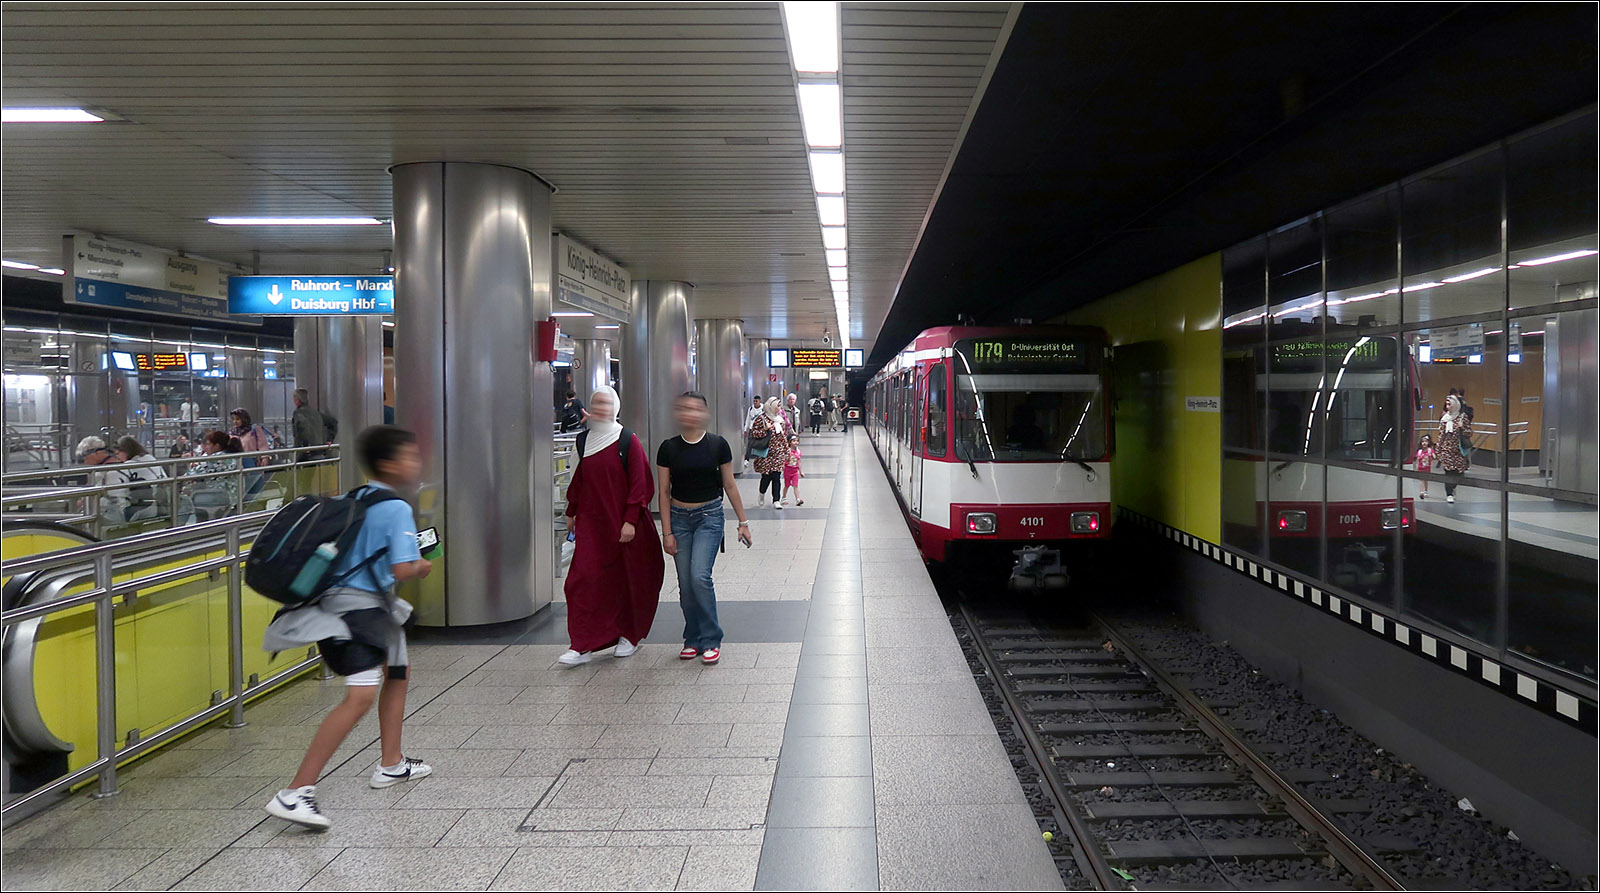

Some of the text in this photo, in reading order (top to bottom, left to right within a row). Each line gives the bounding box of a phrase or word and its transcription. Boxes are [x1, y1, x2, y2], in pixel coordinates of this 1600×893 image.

[567, 244, 626, 293] König-Heinrich-Platz
[291, 279, 341, 291] Ruhrort
[291, 298, 350, 312] Duisburg
[352, 298, 376, 310] Hbf
[975, 342, 1004, 361] U79
[1061, 343, 1075, 351] Ost
[1020, 516, 1044, 526] 4101
